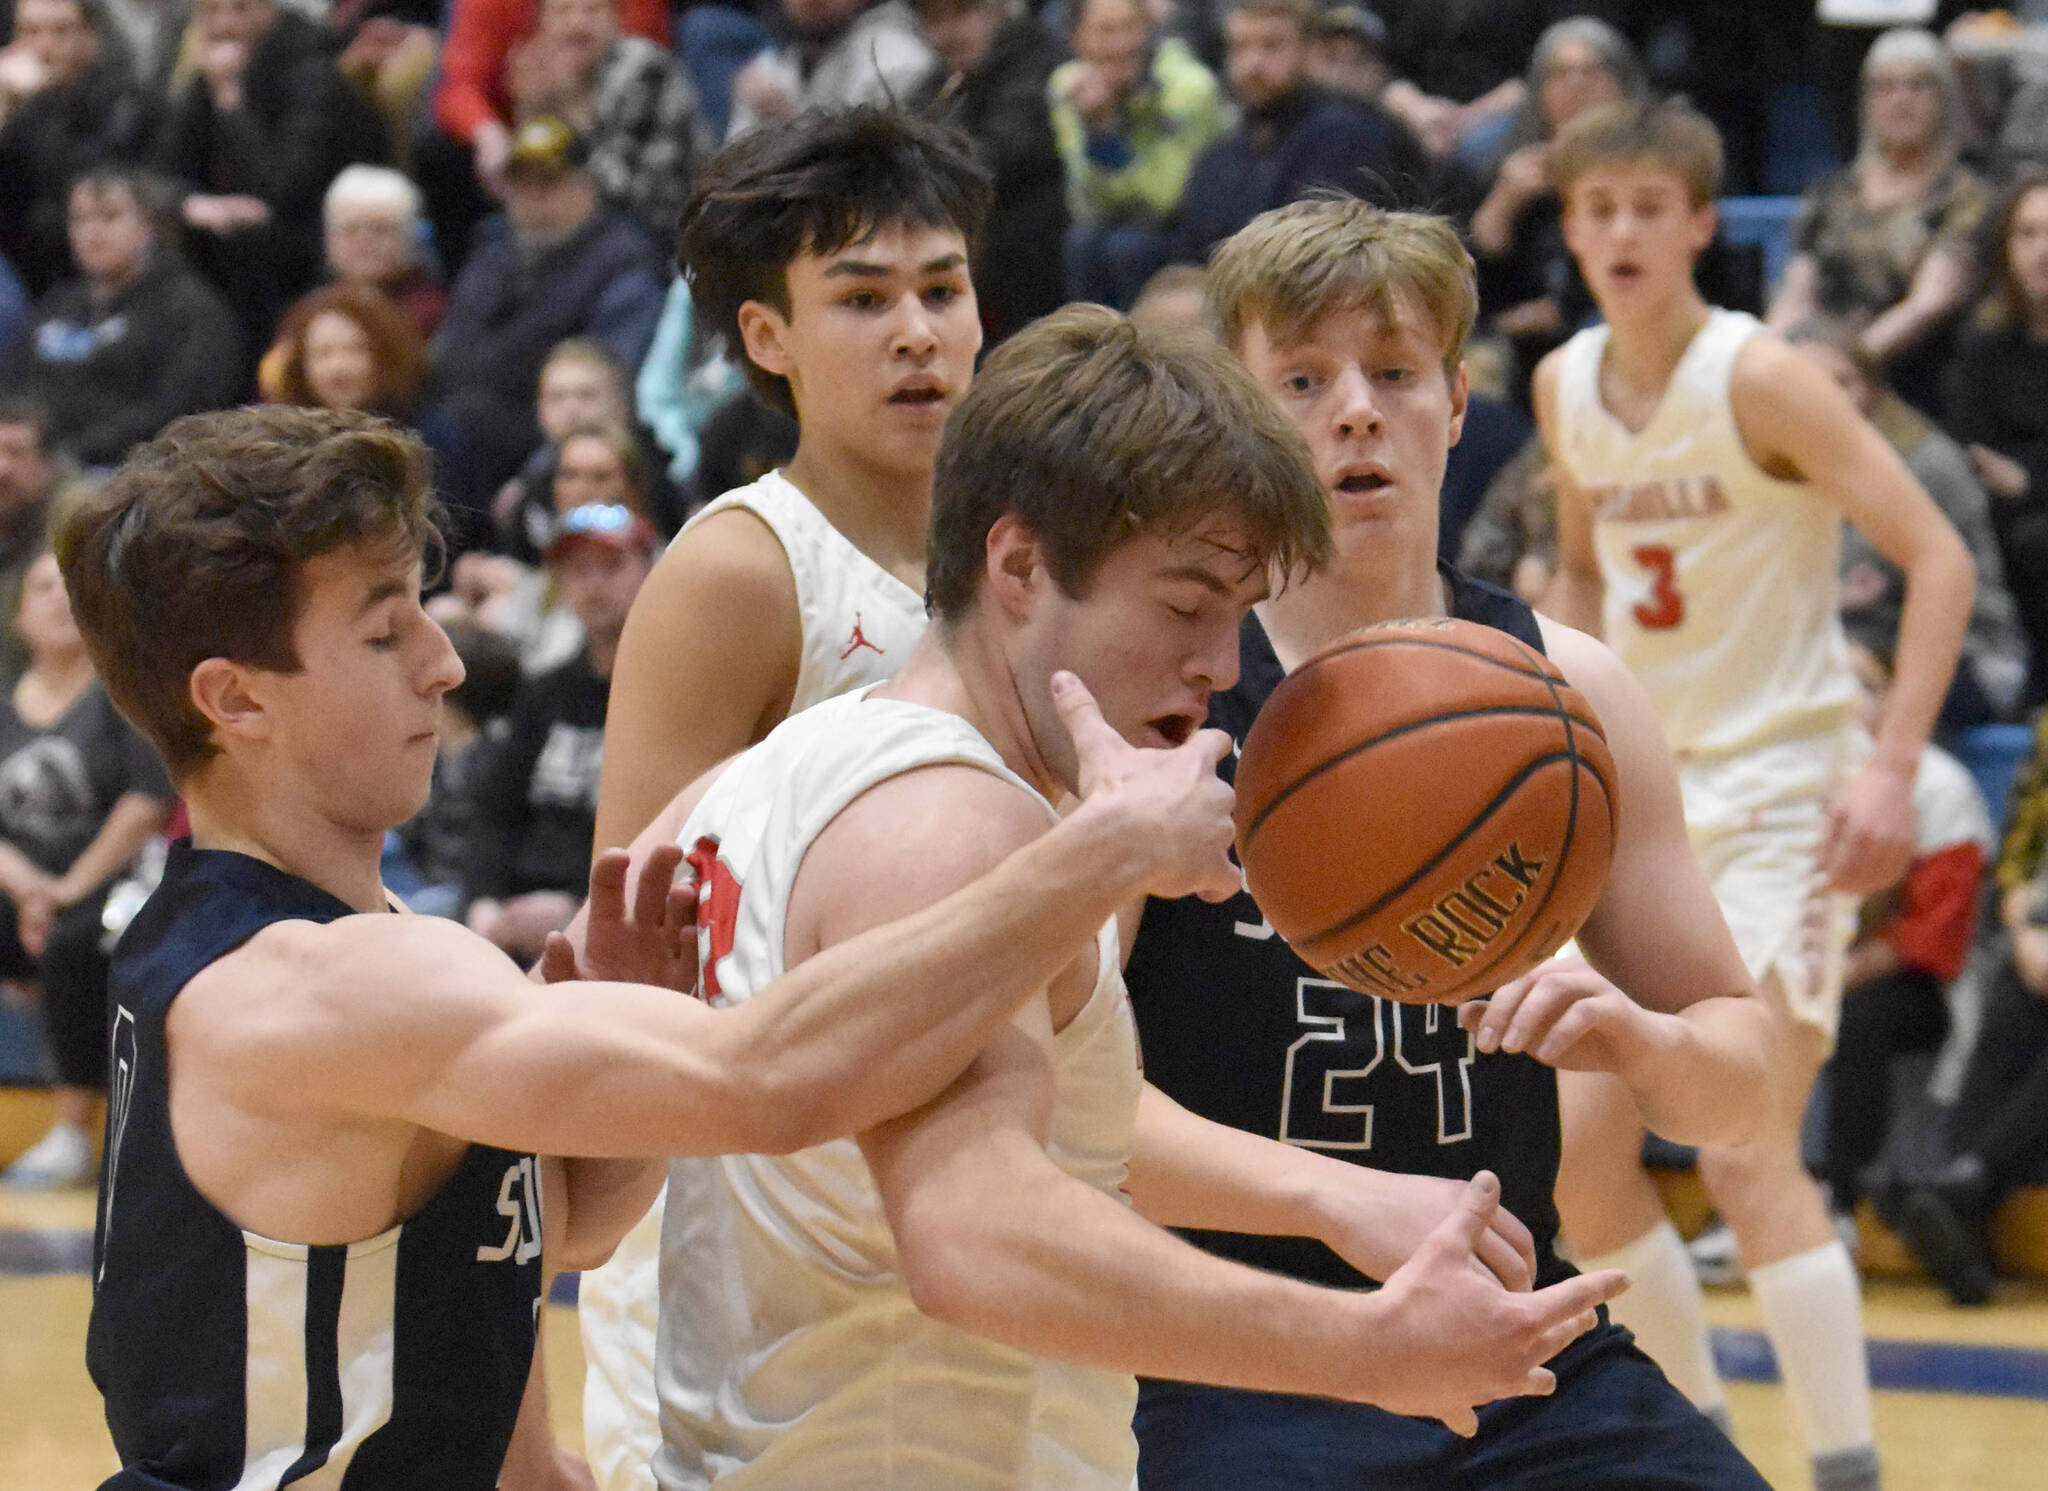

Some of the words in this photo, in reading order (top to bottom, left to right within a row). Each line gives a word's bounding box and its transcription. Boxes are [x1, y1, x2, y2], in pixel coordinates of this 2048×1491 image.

[1632, 543, 1686, 632] 3
[1401, 841, 1547, 968] ROCK
[1279, 975, 1475, 1150] 24
